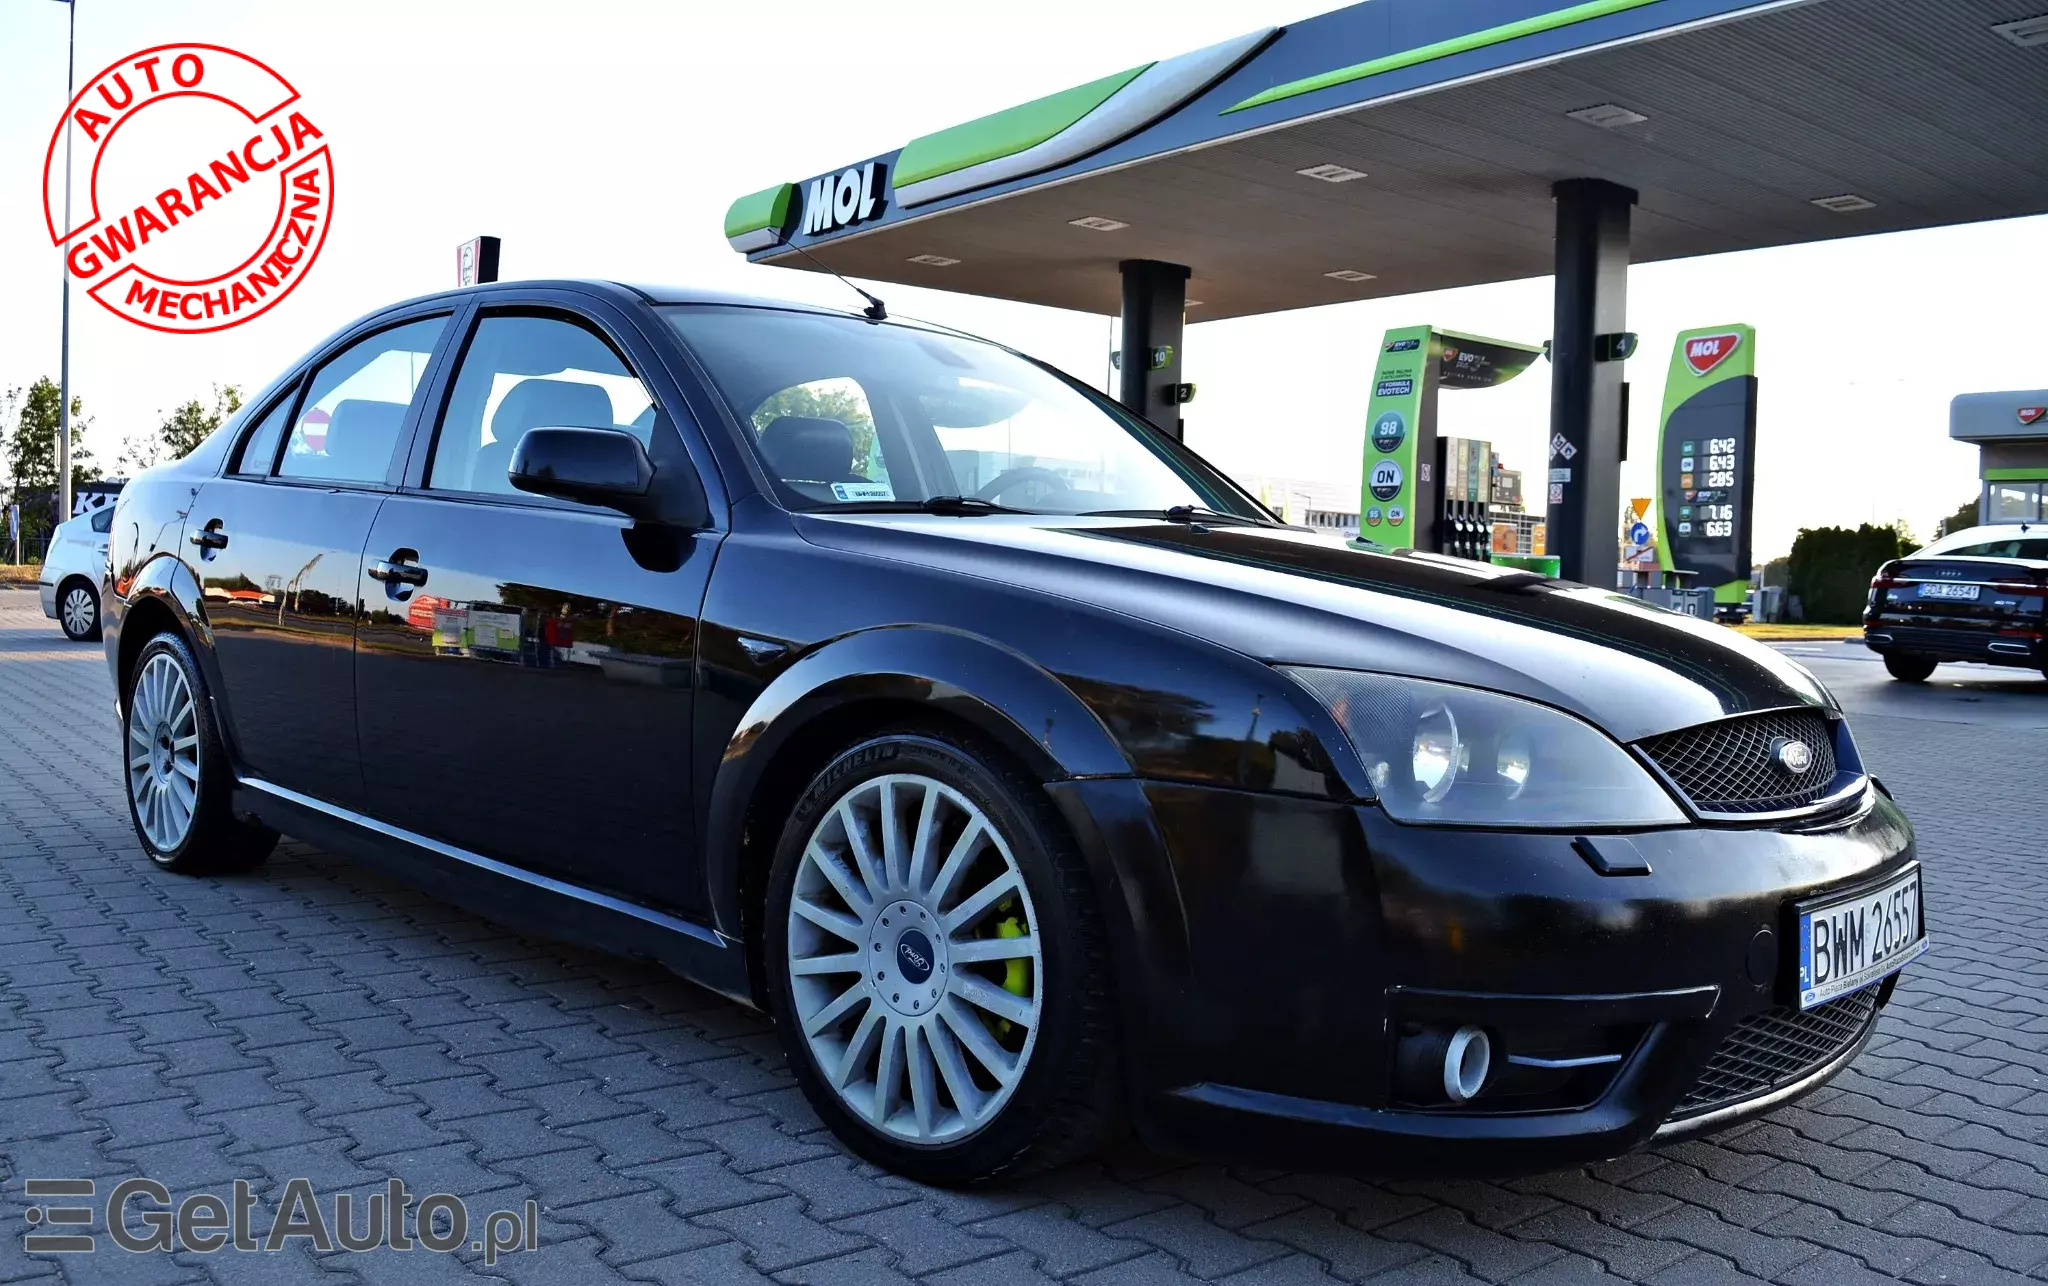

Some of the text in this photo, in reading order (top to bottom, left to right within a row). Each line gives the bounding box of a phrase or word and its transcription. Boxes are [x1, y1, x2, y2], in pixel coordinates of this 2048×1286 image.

[803, 162, 877, 235] MOL
[1616, 339, 1625, 351] 4
[1690, 340, 1720, 357] MOL
[1154, 352, 1165, 362] 10
[1459, 352, 1474, 362] EVO
[1180, 388, 1187, 398] 2
[1378, 387, 1410, 396] EVOTECH
[1380, 421, 1397, 435] 98
[1377, 470, 1394, 483] ON
[1925, 584, 1979, 598] GDA 26541
[813, 745, 895, 800] MICHELIN
[1814, 880, 1917, 985] BWM 26557
[904, 947, 925, 967] Ford
[1800, 965, 1810, 983] PL
